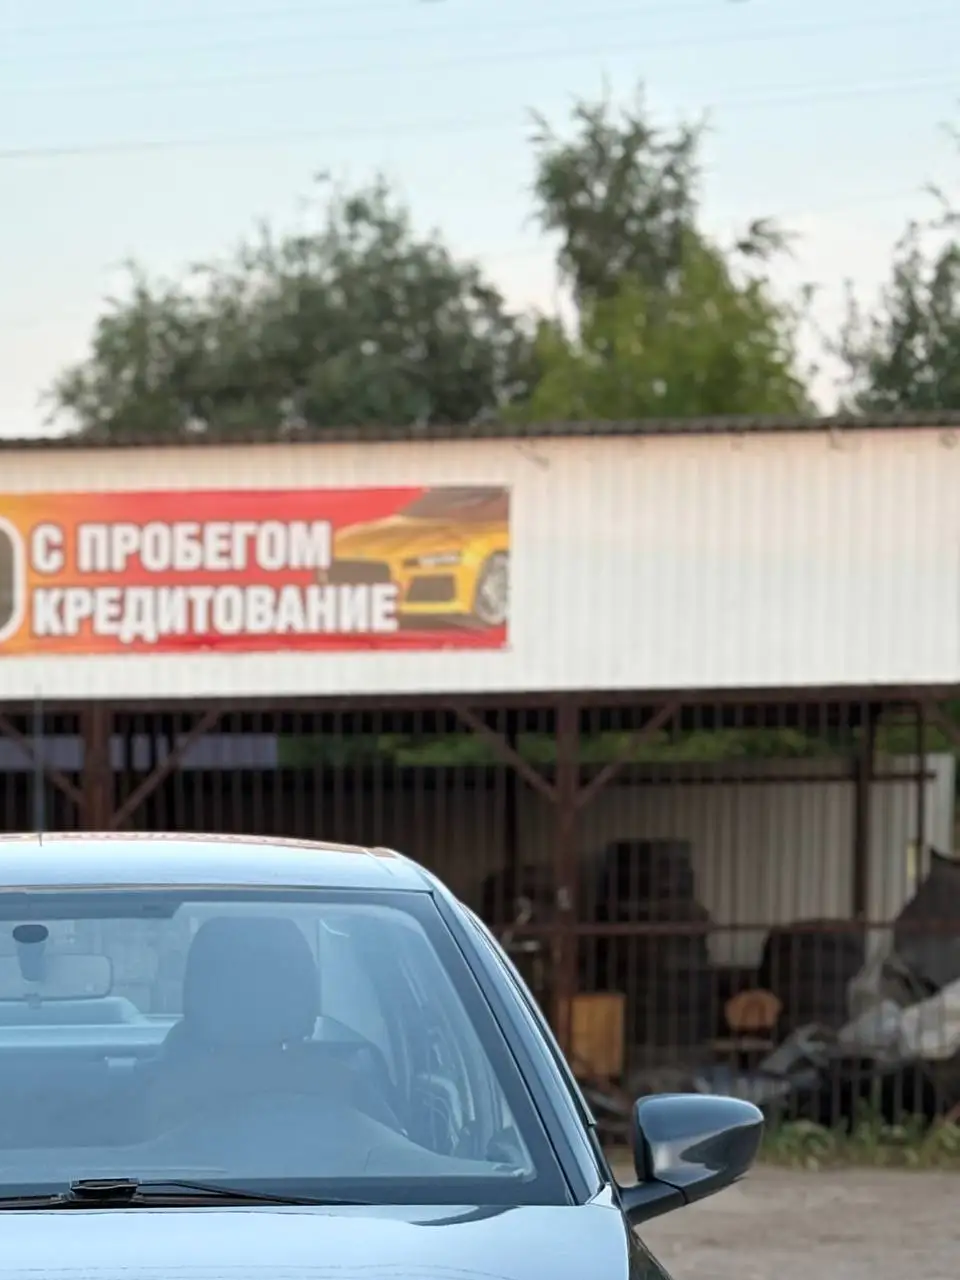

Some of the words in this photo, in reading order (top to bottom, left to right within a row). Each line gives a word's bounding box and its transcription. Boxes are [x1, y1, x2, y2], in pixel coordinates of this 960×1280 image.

[30, 525, 64, 573] С
[77, 519, 333, 572] ПРОБЕГОМ
[32, 584, 399, 644] КРЕДИТОВАНИЕ
